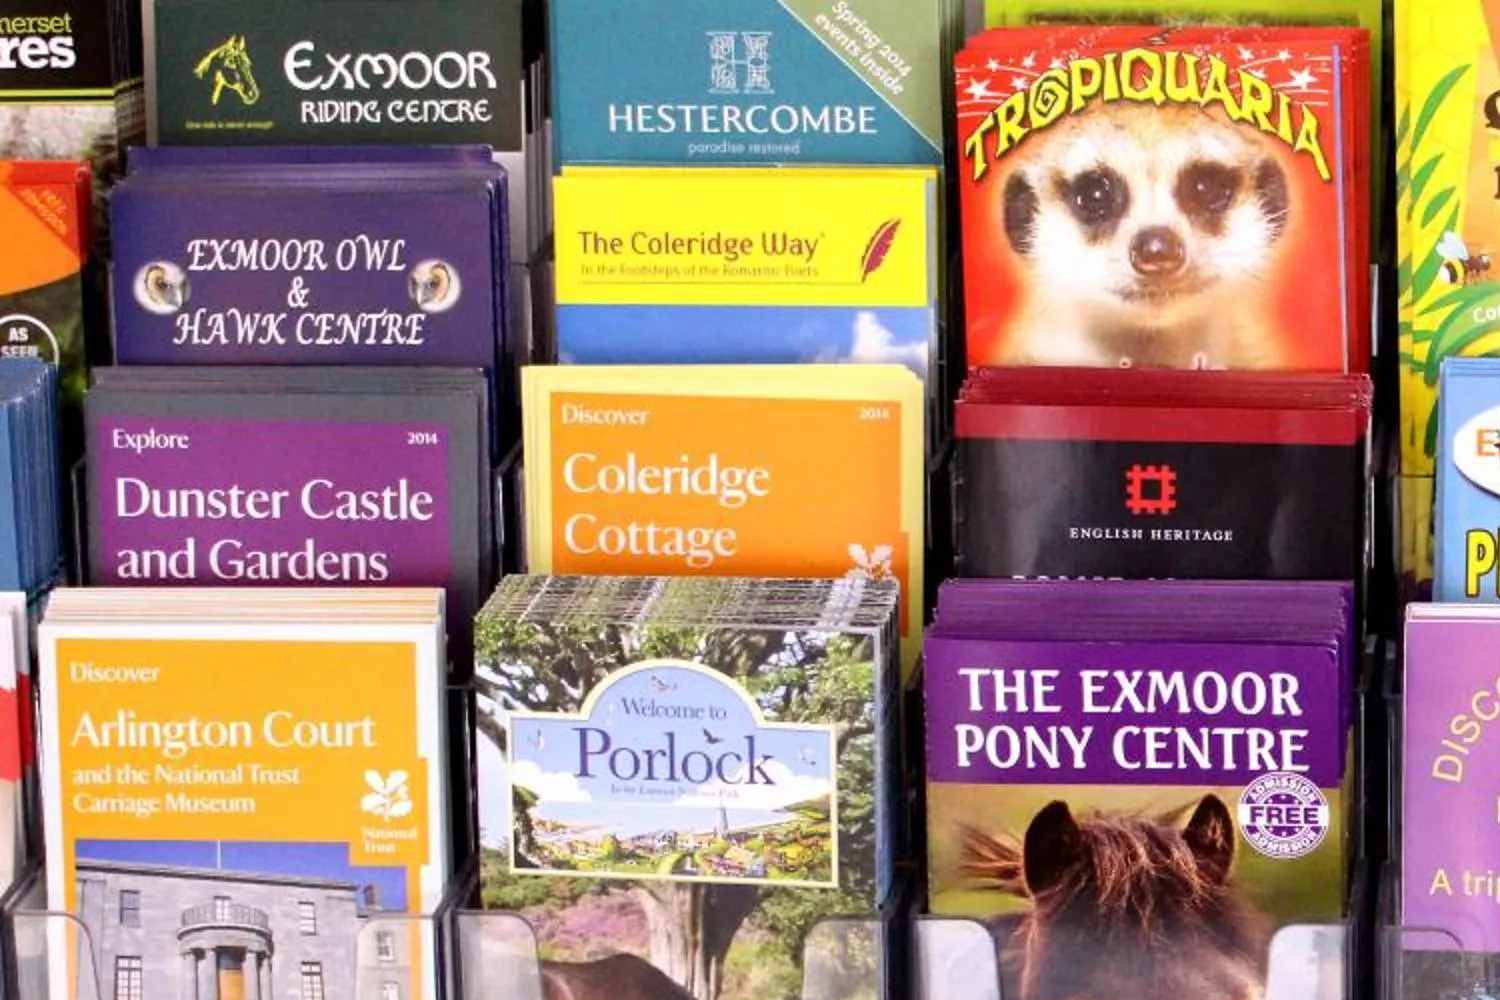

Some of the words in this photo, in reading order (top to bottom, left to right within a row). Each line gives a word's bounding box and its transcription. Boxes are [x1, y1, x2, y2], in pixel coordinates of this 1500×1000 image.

[813, 12, 861, 57] events
[859, 55, 904, 95] inside
[301, 100, 381, 124] RIDING
[388, 100, 492, 123] CENTRE
[608, 104, 878, 134] HESTERCOMBE
[964, 48, 1332, 182] TROPIQUARIA
[688, 141, 744, 155] paradise
[749, 141, 800, 154] restored
[186, 237, 327, 271] EXMOOR
[336, 234, 406, 271] OWL
[578, 232, 624, 255] The
[631, 232, 753, 261] Coleridge
[287, 277, 309, 309] &
[9, 327, 28, 341] AS
[173, 313, 287, 346] HAWK
[296, 313, 427, 346] CENTRE
[561, 404, 650, 426] Discover
[859, 407, 890, 420] 2014
[112, 429, 190, 452] Explore
[407, 432, 438, 445] 2014
[562, 452, 770, 506] Coleridge
[115, 477, 289, 520] Dunster
[300, 478, 434, 521] Castle
[563, 513, 737, 568] Cottage
[1069, 527, 1143, 541] ENGLISH
[1151, 527, 1234, 541] HERITAGE
[117, 539, 196, 580] and
[209, 540, 389, 582] Gardens
[70, 663, 160, 682] Discover
[959, 668, 1061, 712] THE
[1079, 670, 1303, 716] EXMOOR
[621, 697, 705, 720] Welcome
[709, 704, 727, 720] to
[71, 711, 251, 756] Arlington
[264, 712, 375, 748] Court
[573, 727, 776, 786] Porlock
[955, 724, 1093, 769] PONY
[1112, 726, 1310, 772] CENTRE
[73, 766, 111, 784] and
[117, 766, 148, 784] the
[155, 766, 242, 785] National
[250, 767, 300, 785] Trust
[1248, 772, 1319, 803] ADMISSION
[73, 793, 160, 818] Carriage
[166, 794, 255, 812] Museum
[1249, 806, 1319, 826] FREE
[362, 827, 417, 840] National
[364, 842, 396, 854] Trust
[1430, 869, 1452, 895] A
